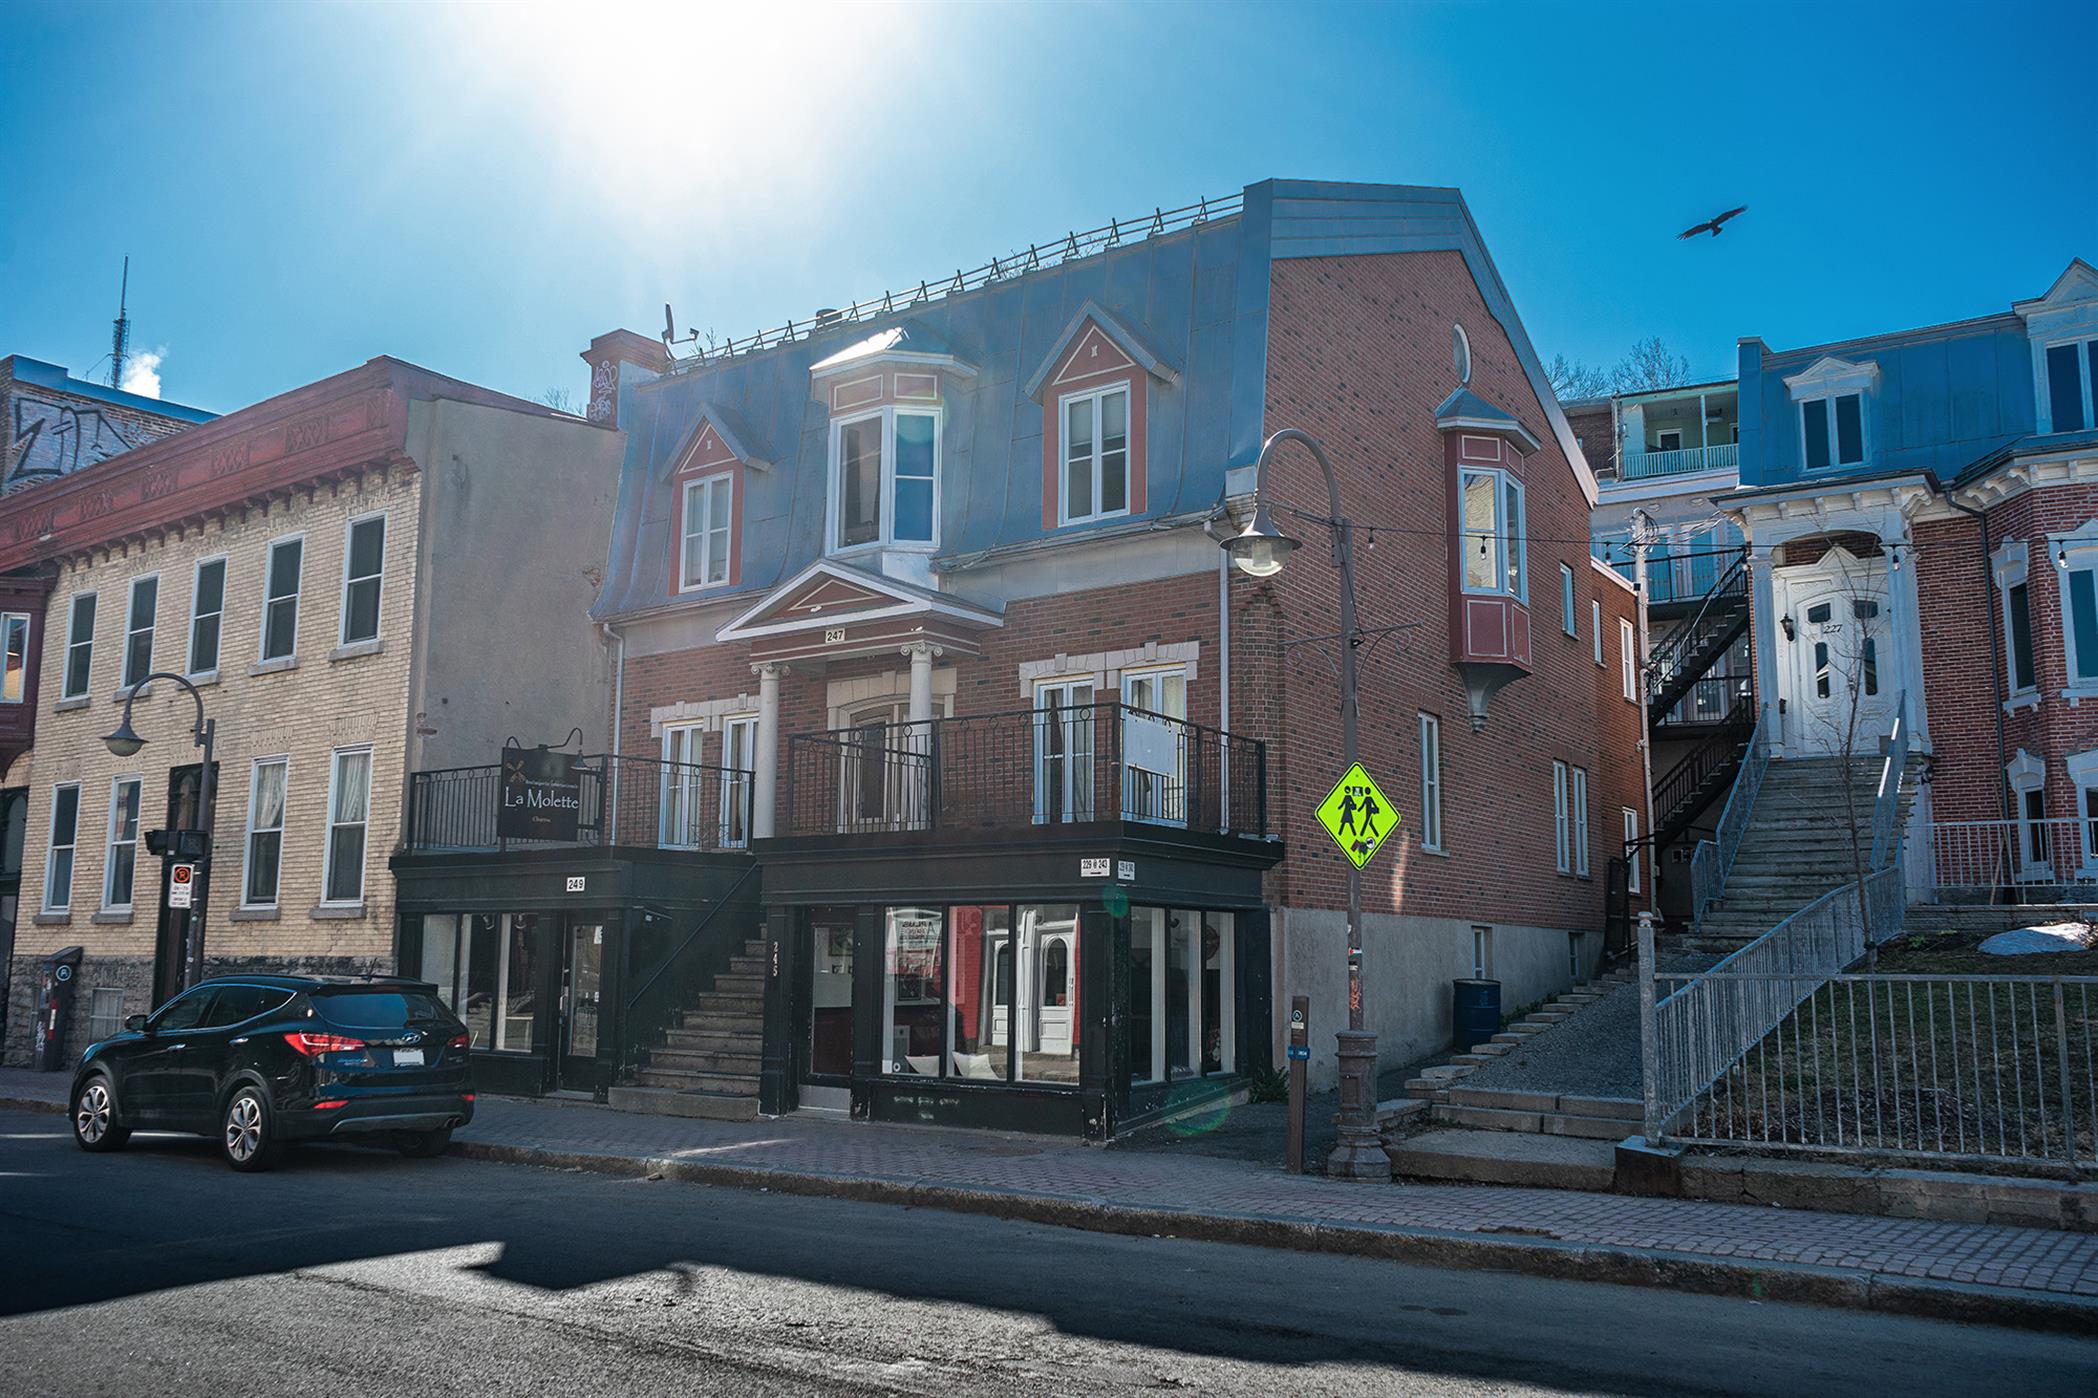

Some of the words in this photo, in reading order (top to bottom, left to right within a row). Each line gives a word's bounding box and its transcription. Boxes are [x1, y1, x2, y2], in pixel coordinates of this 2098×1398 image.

[1823, 623, 1843, 634] 227
[827, 630, 844, 642] 247
[504, 786, 524, 808] La
[526, 788, 579, 810] Molette
[568, 879, 583, 890] 249
